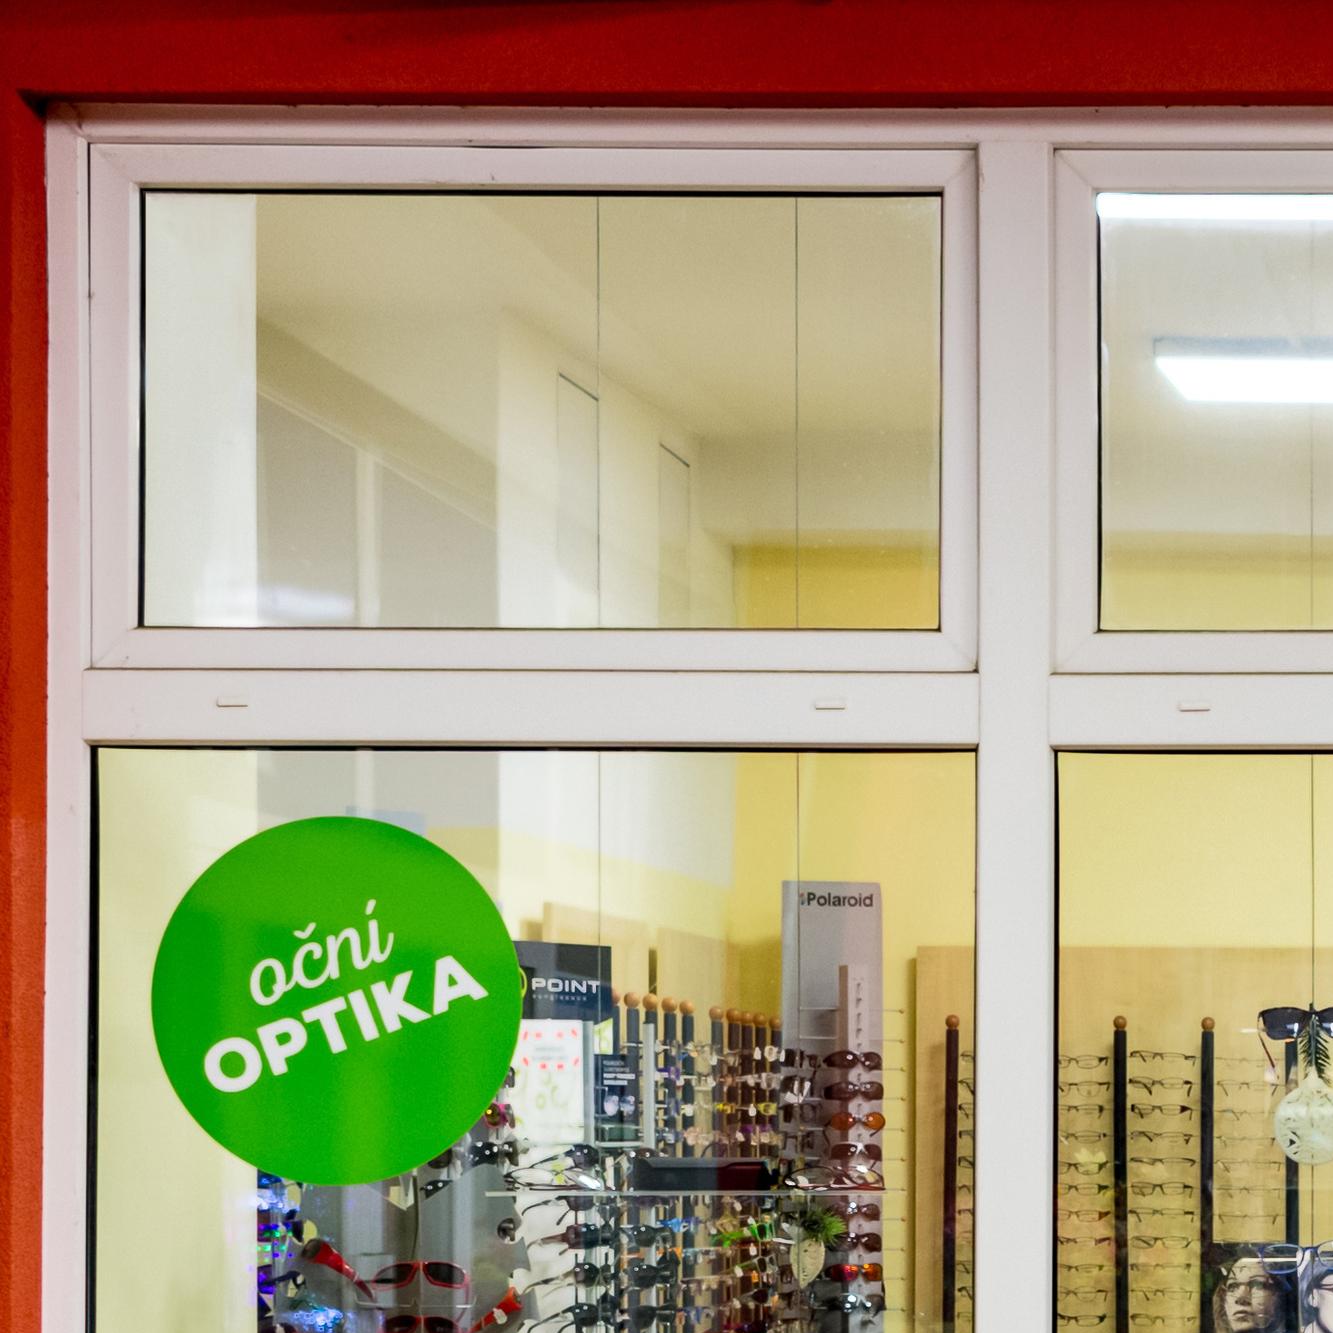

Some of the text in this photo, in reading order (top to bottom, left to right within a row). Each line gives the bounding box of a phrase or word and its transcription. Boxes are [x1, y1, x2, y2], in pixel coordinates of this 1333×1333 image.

[807, 892, 874, 907] Polaroid
[250, 899, 394, 1006] oční
[531, 977, 600, 994] POINT
[204, 955, 489, 1093] OPTIKA
